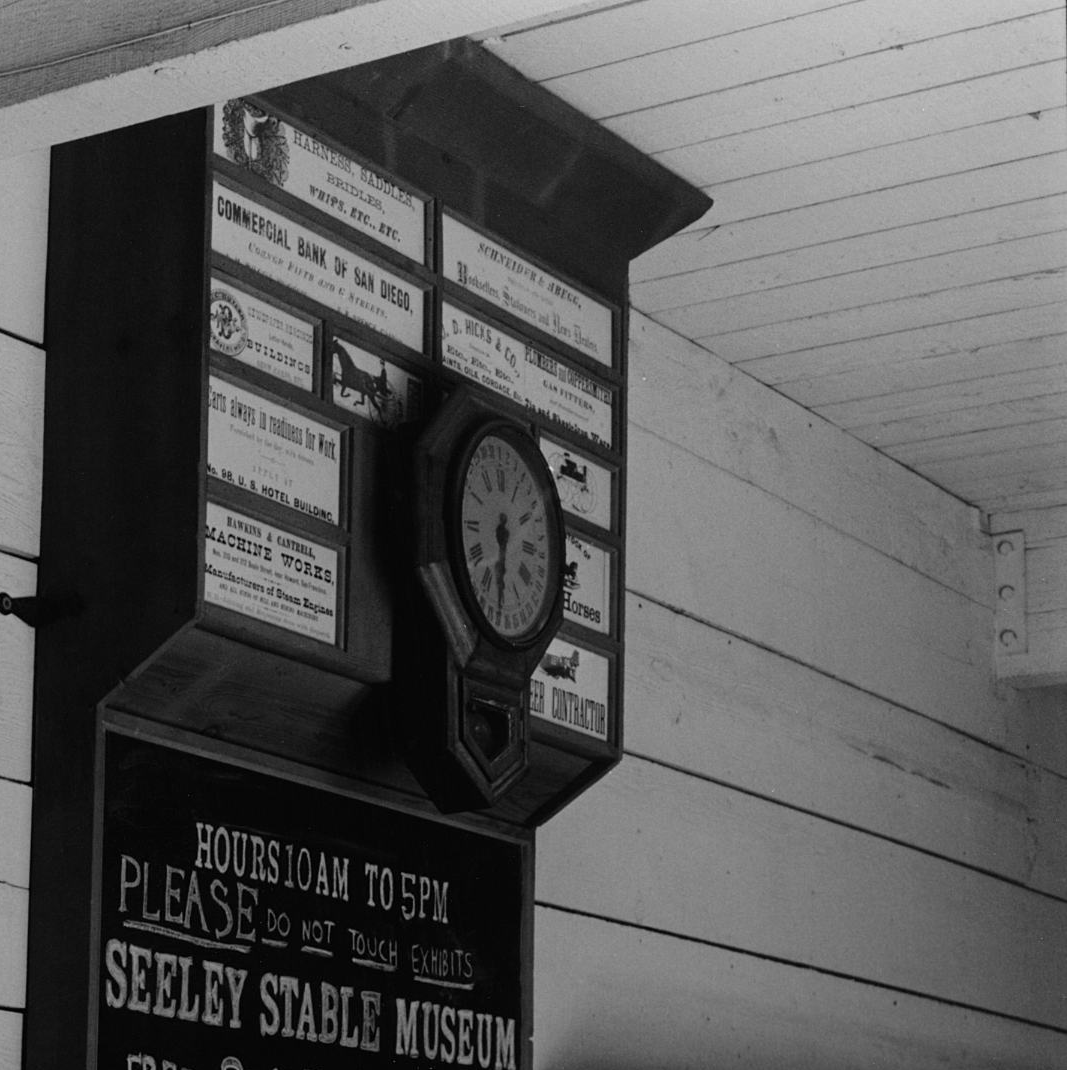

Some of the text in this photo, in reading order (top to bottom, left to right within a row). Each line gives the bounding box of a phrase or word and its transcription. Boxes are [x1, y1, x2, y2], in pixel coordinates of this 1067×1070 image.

[293, 129, 416, 212] HARNESS, SADDLES,
[326, 172, 386, 215] BRIDLES,
[309, 184, 347, 214] WHIPS,
[379, 222, 401, 243] ETC.
[217, 195, 291, 251] COMMERCIAL
[297, 236, 327, 270] BANK
[334, 256, 348, 279] OF
[354, 266, 374, 294] SAN
[380, 279, 414, 317] DIEGO,
[477, 242, 537, 282] SCHNEIDER
[247, 338, 311, 375] BUILDINGS
[452, 319, 463, 335] D.
[465, 318, 492, 346] HICKS
[495, 337, 502, 353] &
[482, 374, 512, 396] CORDAGE,
[524, 345, 558, 378] PLUMBERS
[543, 379, 558, 394] GAS
[230, 396, 256, 427] always
[259, 407, 266, 431] in
[269, 415, 303, 446] readiness
[305, 427, 316, 451] for
[238, 474, 247, 488] U.
[262, 484, 290, 505] HOTEL
[205, 525, 334, 587] MACHINE WORKS,
[226, 516, 316, 560] HAWKINS & CANTRELL,
[204, 563, 334, 618] Manufacturers of Steam Engines
[563, 592, 601, 624] Horses
[552, 686, 605, 736] CONTRACTOR
[195, 822, 280, 884] HOURS
[365, 862, 394, 911] TO
[401, 872, 449, 924] 5PM
[118, 853, 474, 979] PLEASE DO NOT TOUCH EXHIBITS
[105, 938, 248, 1029] SEELEY
[259, 972, 381, 1052] STABLE
